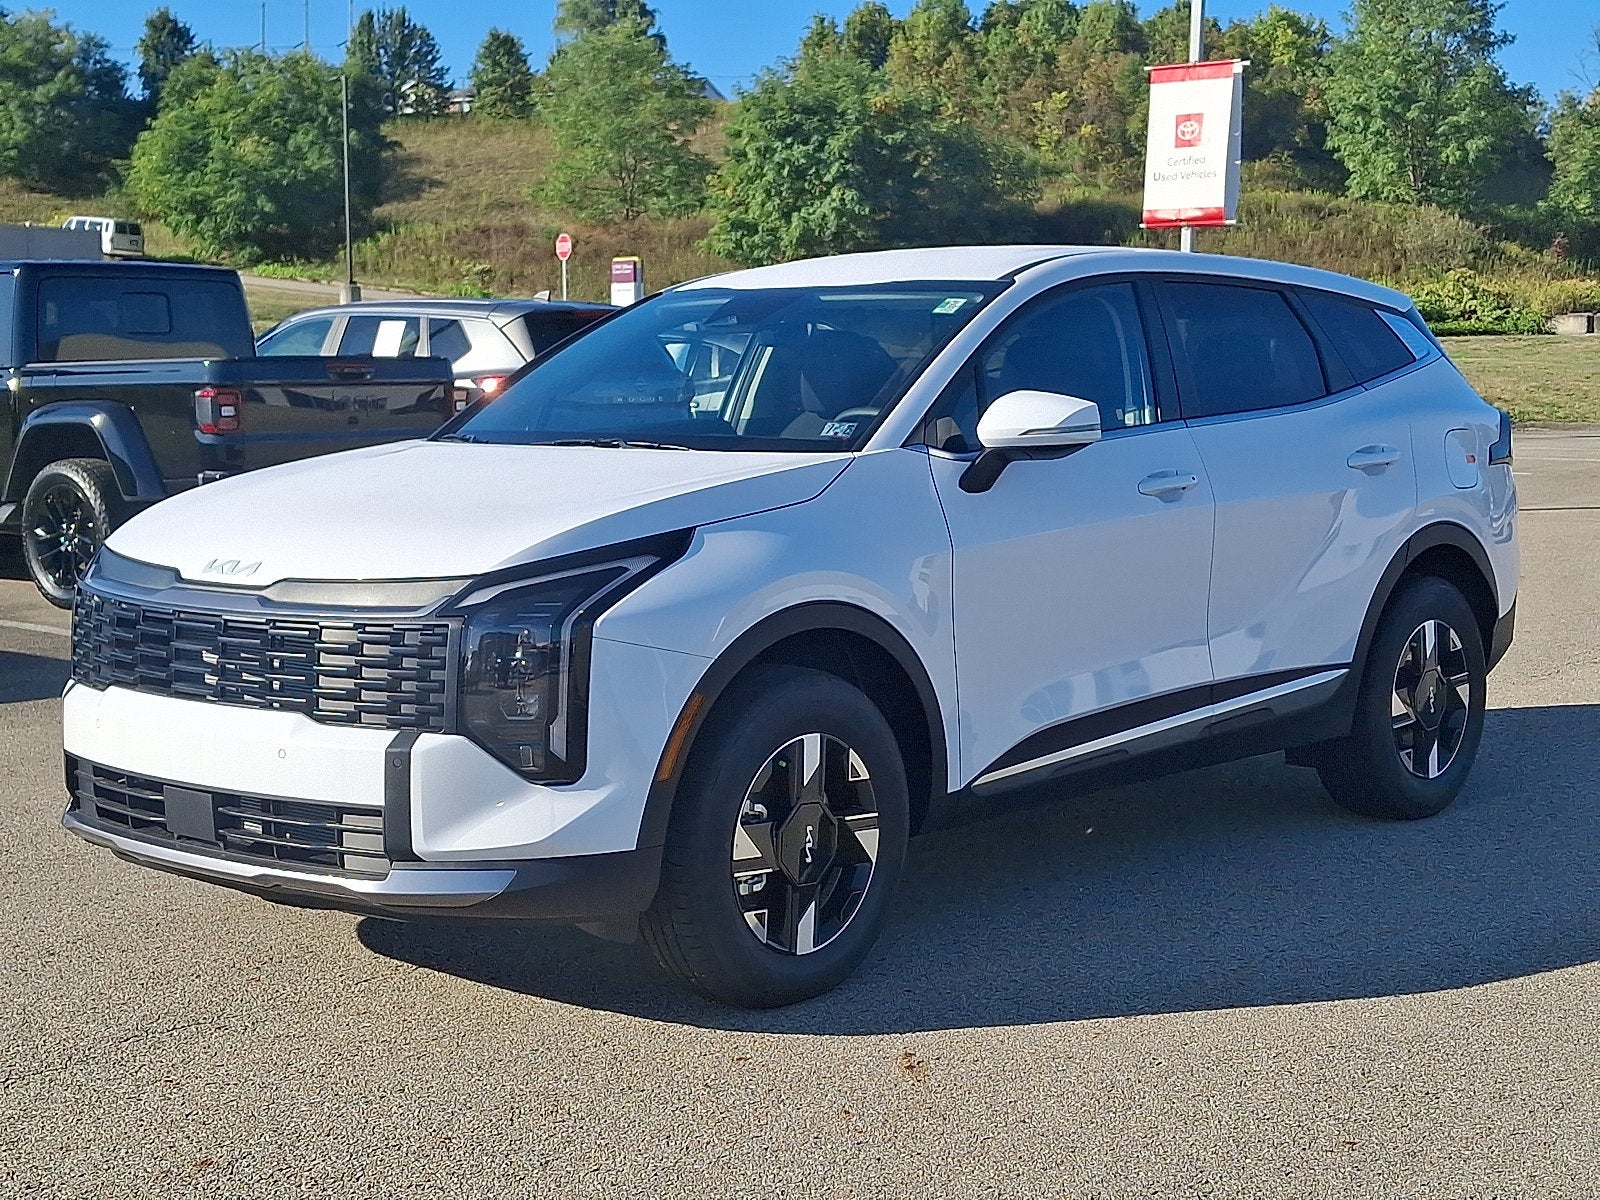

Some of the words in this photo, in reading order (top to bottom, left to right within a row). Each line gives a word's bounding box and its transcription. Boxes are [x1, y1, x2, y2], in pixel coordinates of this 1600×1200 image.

[1167, 155, 1206, 167] Certified
[1153, 171, 1178, 182] Used
[1180, 169, 1217, 180] Vehicles
[202, 558, 262, 577] KIA
